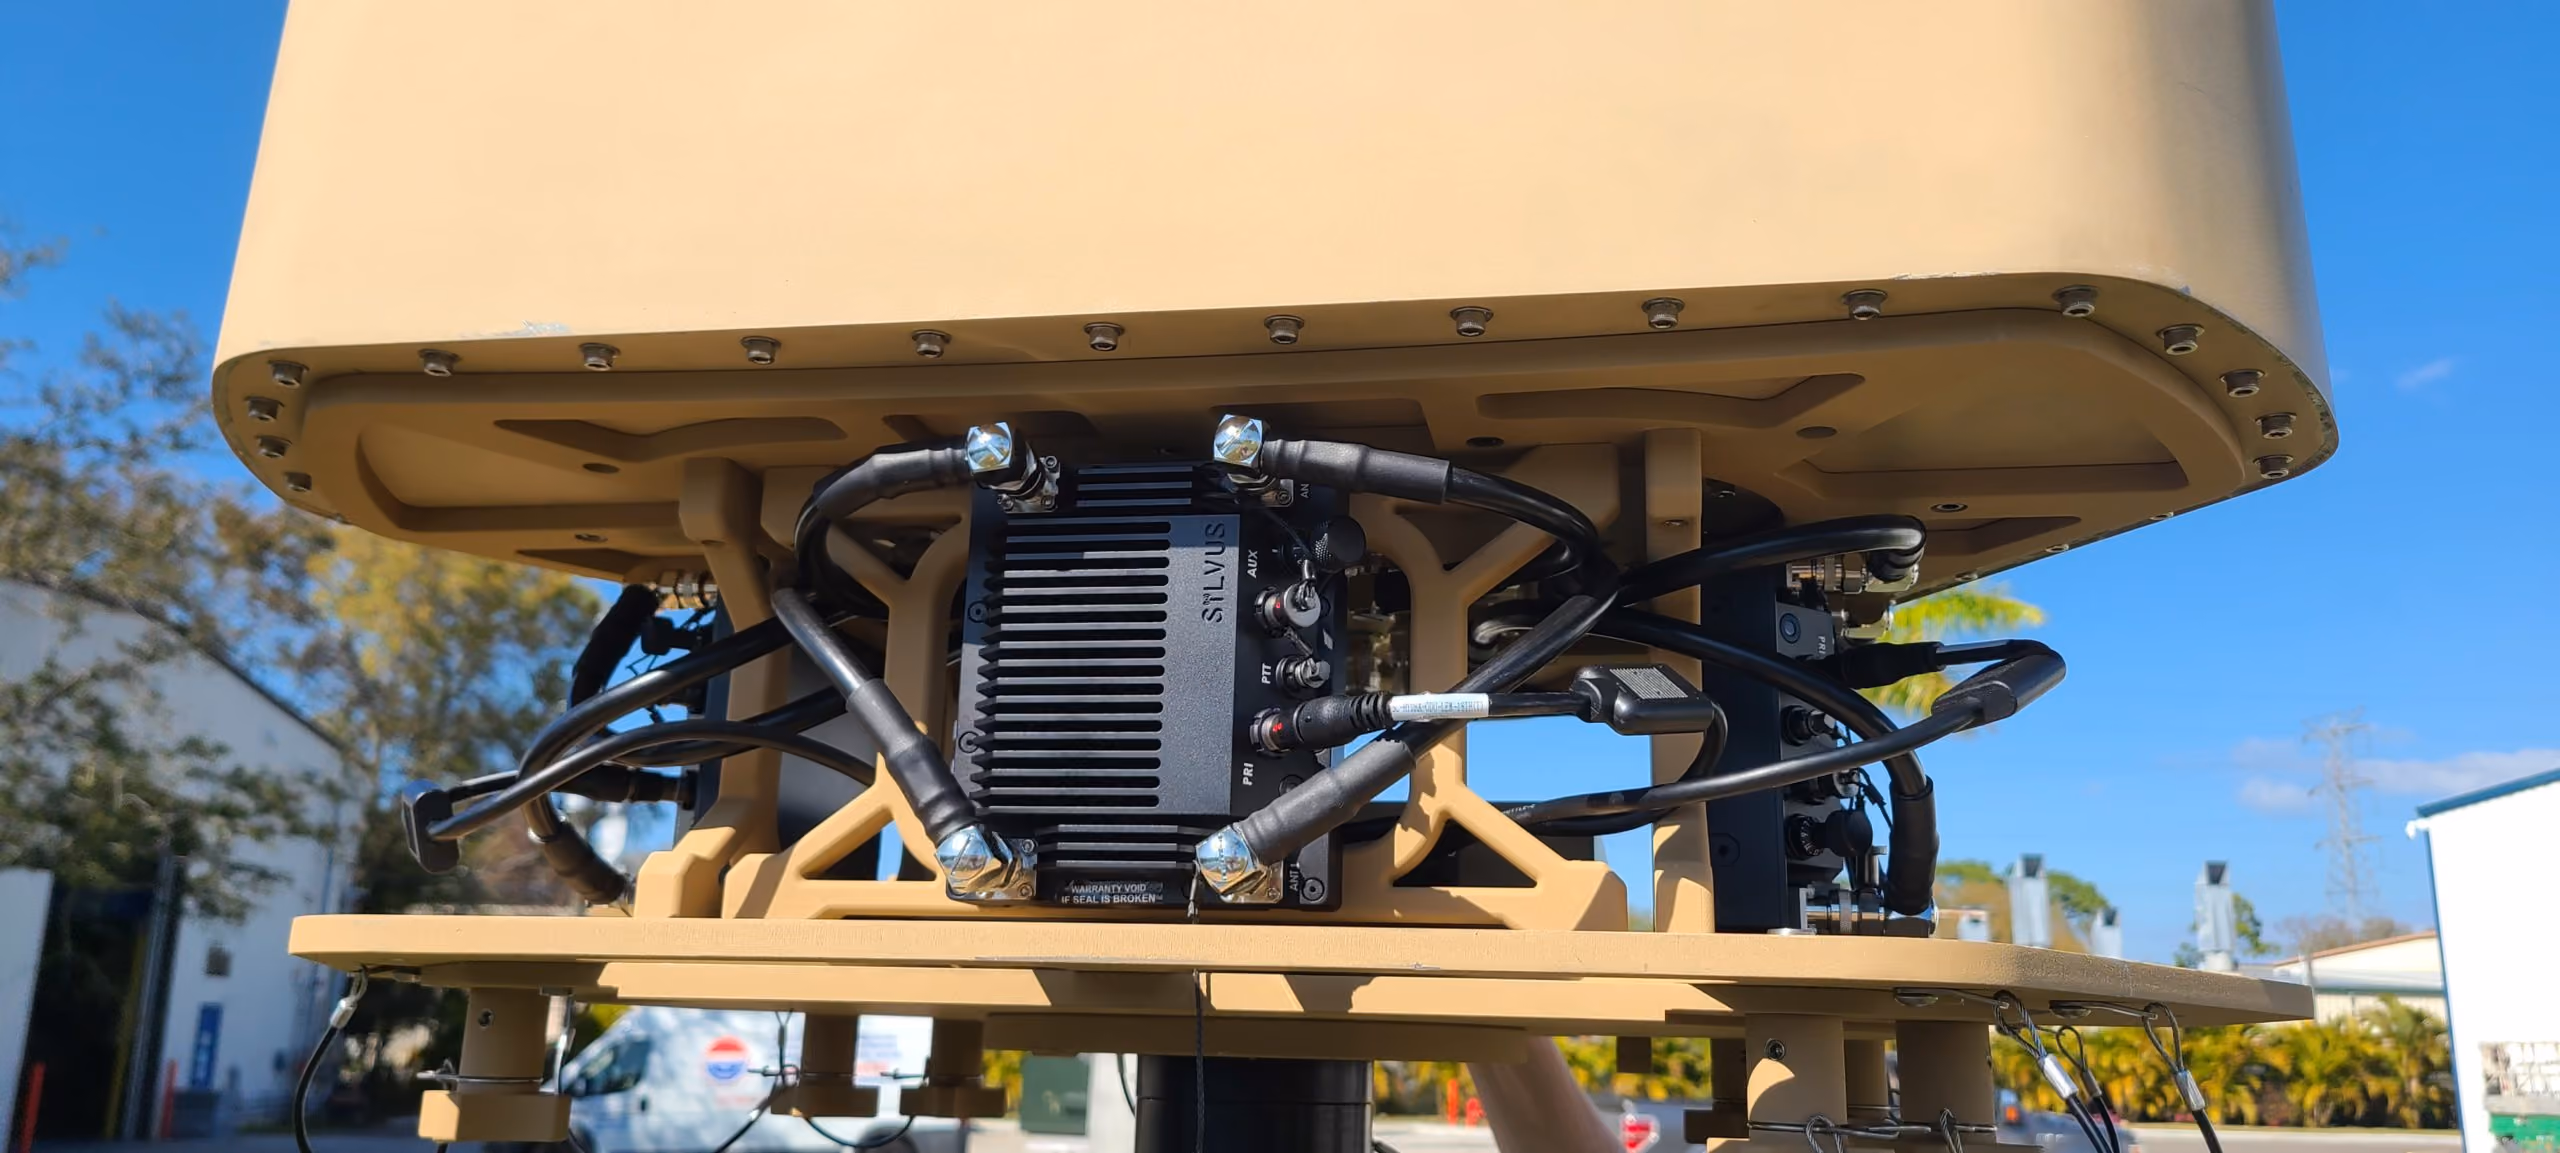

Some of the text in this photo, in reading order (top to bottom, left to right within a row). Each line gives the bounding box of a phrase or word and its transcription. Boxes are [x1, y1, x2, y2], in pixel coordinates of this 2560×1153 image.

[1300, 483, 1309, 498] AN
[1247, 549, 1258, 578] AUX
[1817, 635, 1826, 655] PRI
[1261, 663, 1272, 684] PTT
[1242, 762, 1254, 786] PRI
[1071, 883, 1147, 894] WARRANTY VOID
[1289, 870, 1299, 891] ANT
[1061, 893, 1156, 904] IF SEAL IS BROKEN
